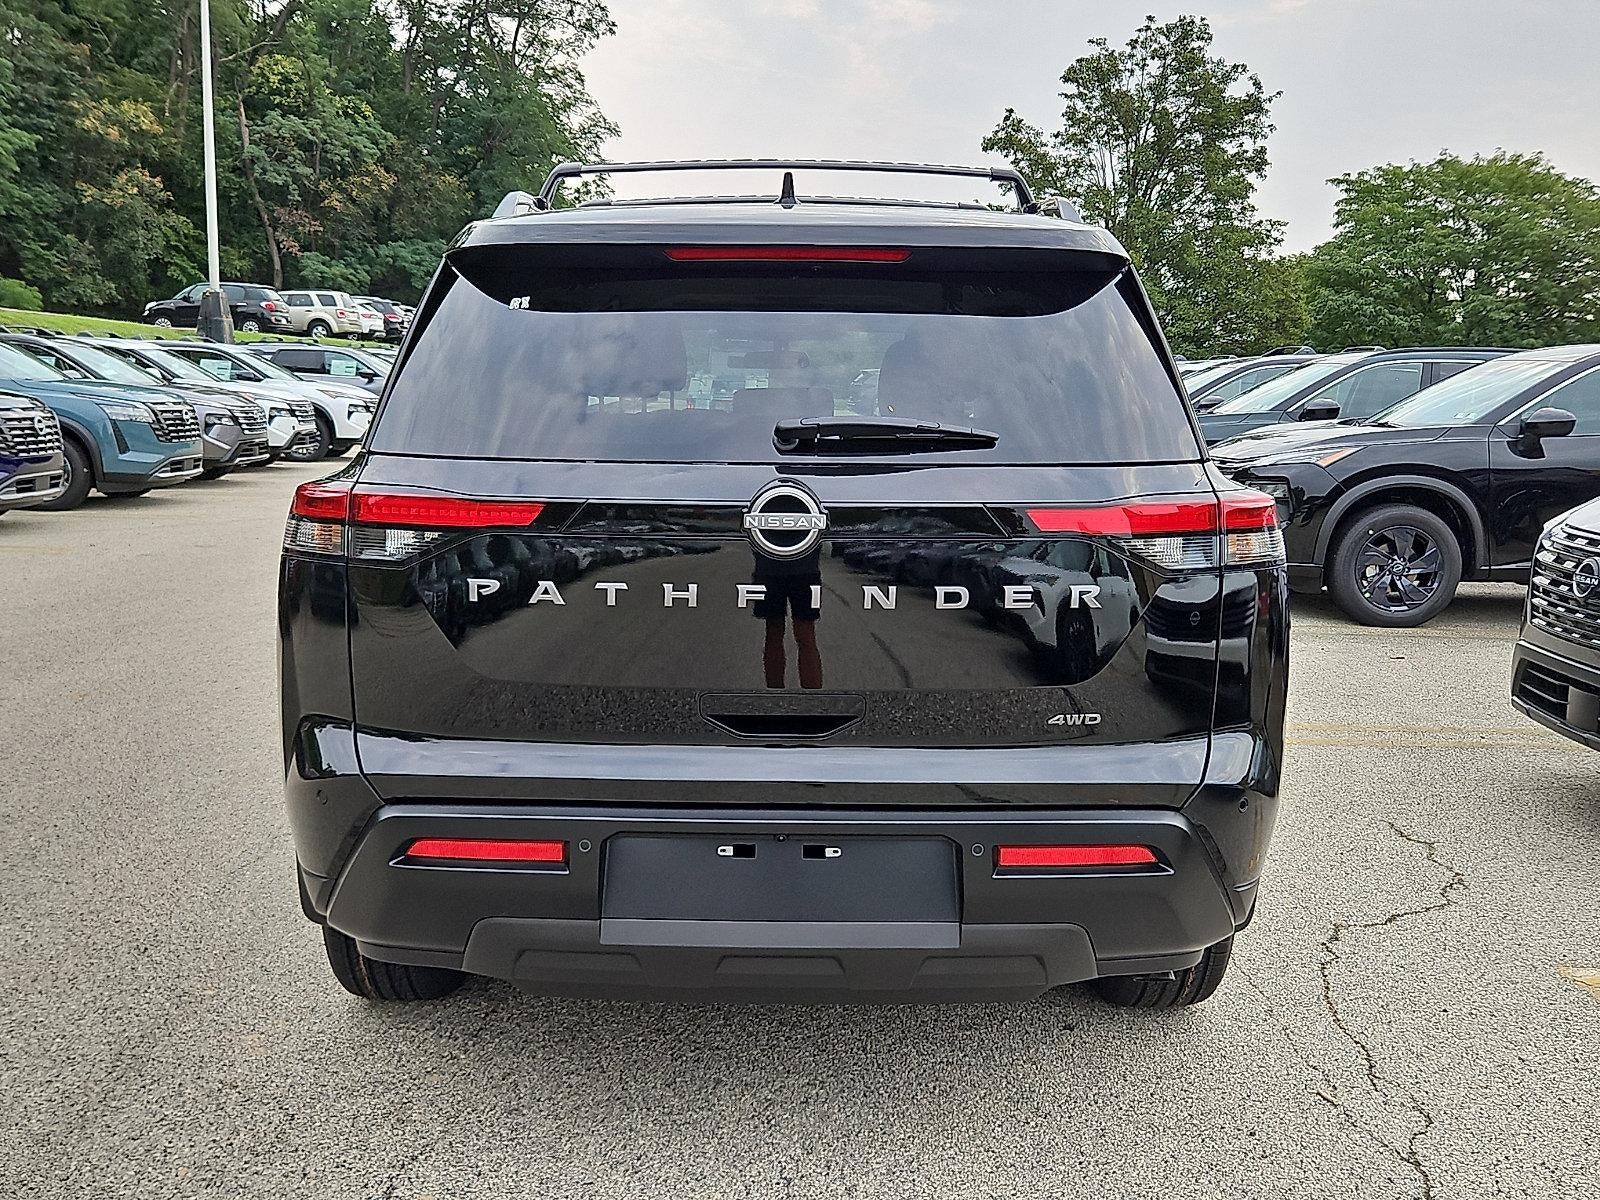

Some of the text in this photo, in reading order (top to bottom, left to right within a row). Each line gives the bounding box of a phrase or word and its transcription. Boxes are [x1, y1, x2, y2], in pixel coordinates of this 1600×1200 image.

[744, 515, 825, 528] NISSAN
[466, 577, 1103, 610] PATHFINDER
[1047, 713, 1102, 726] 4WD
